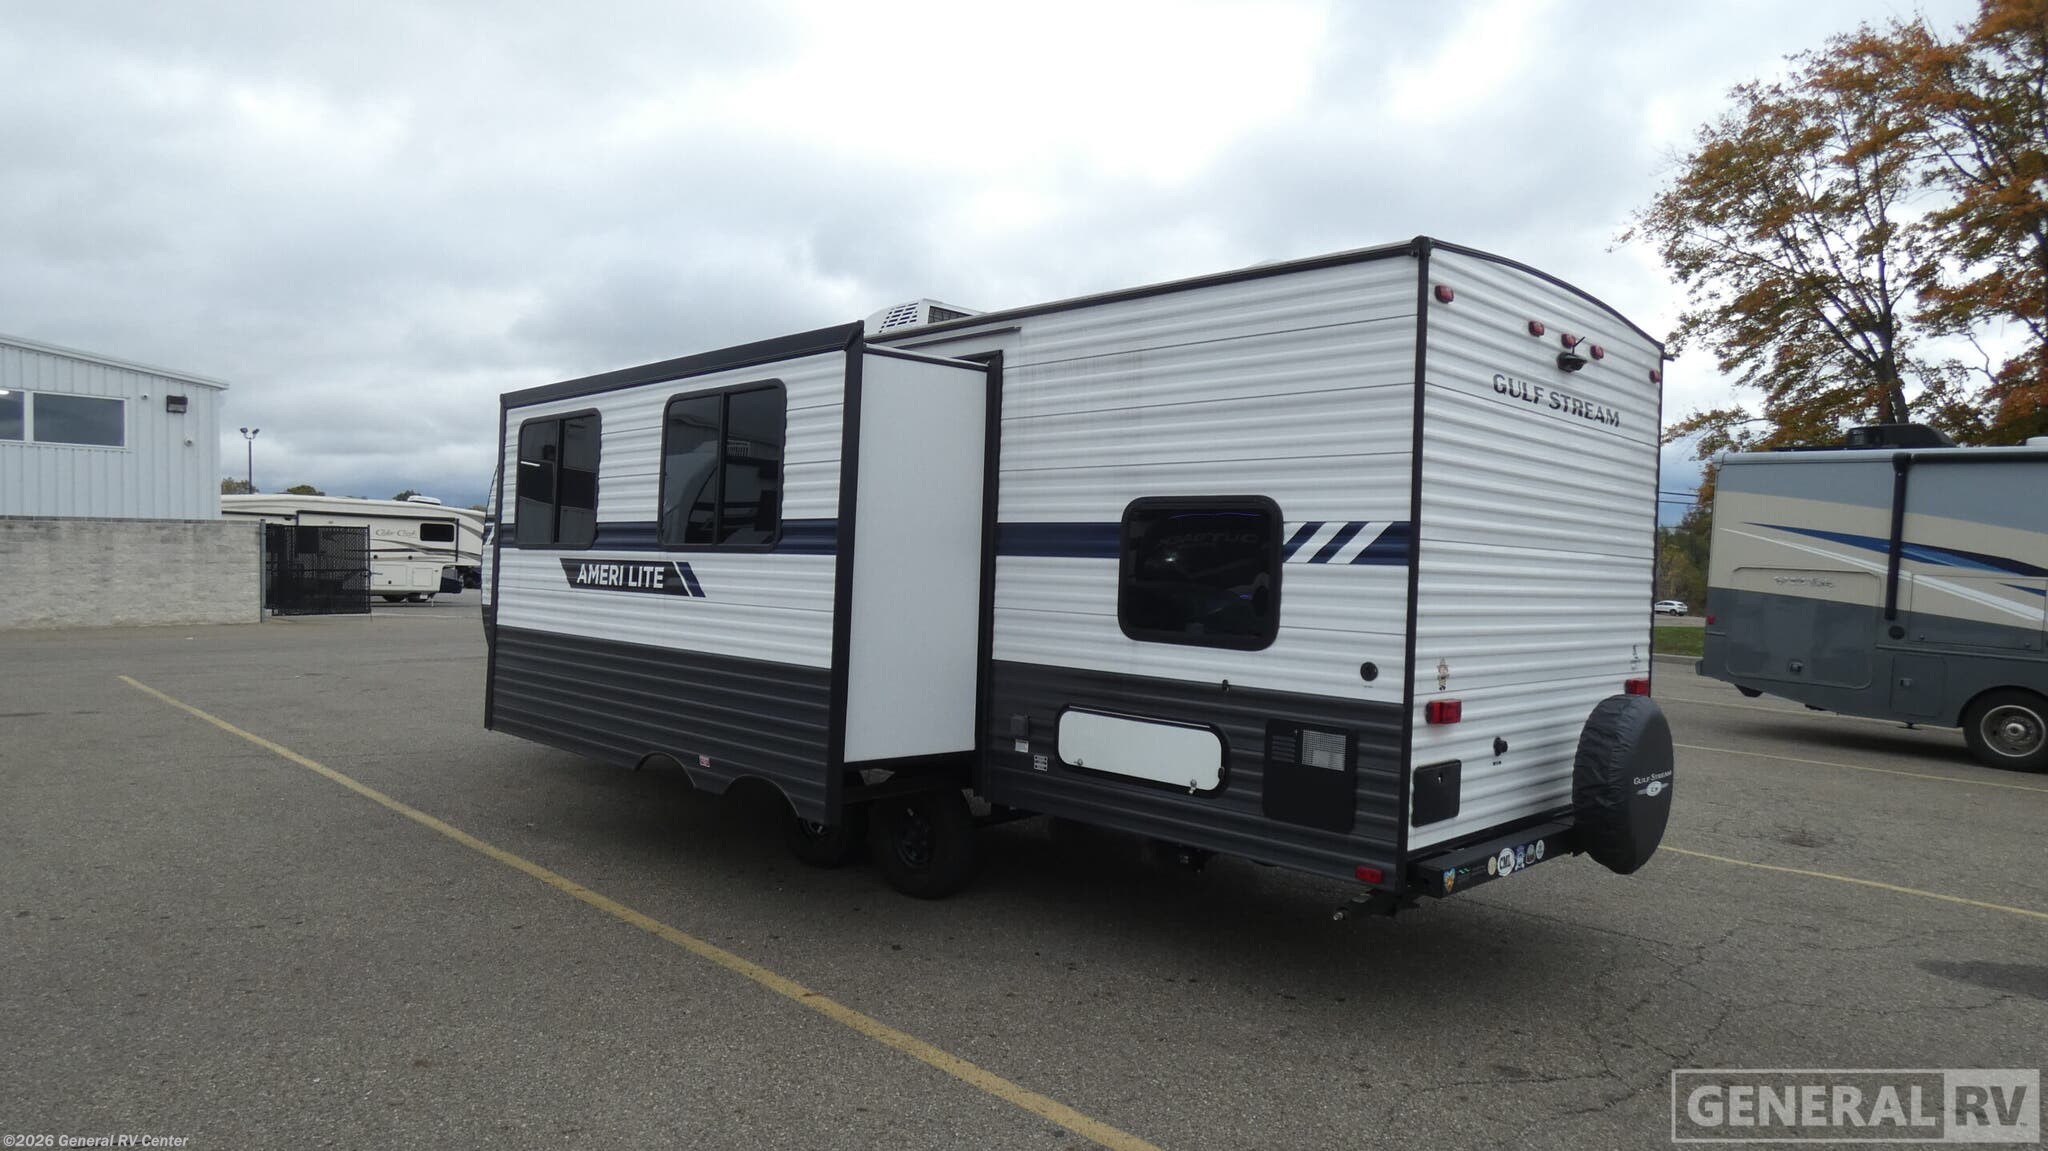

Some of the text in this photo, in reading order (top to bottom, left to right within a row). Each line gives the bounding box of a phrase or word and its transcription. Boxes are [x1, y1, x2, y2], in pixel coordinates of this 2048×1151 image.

[1492, 373, 1620, 428] GULF STREAM
[576, 563, 665, 589] AMERI LITE
